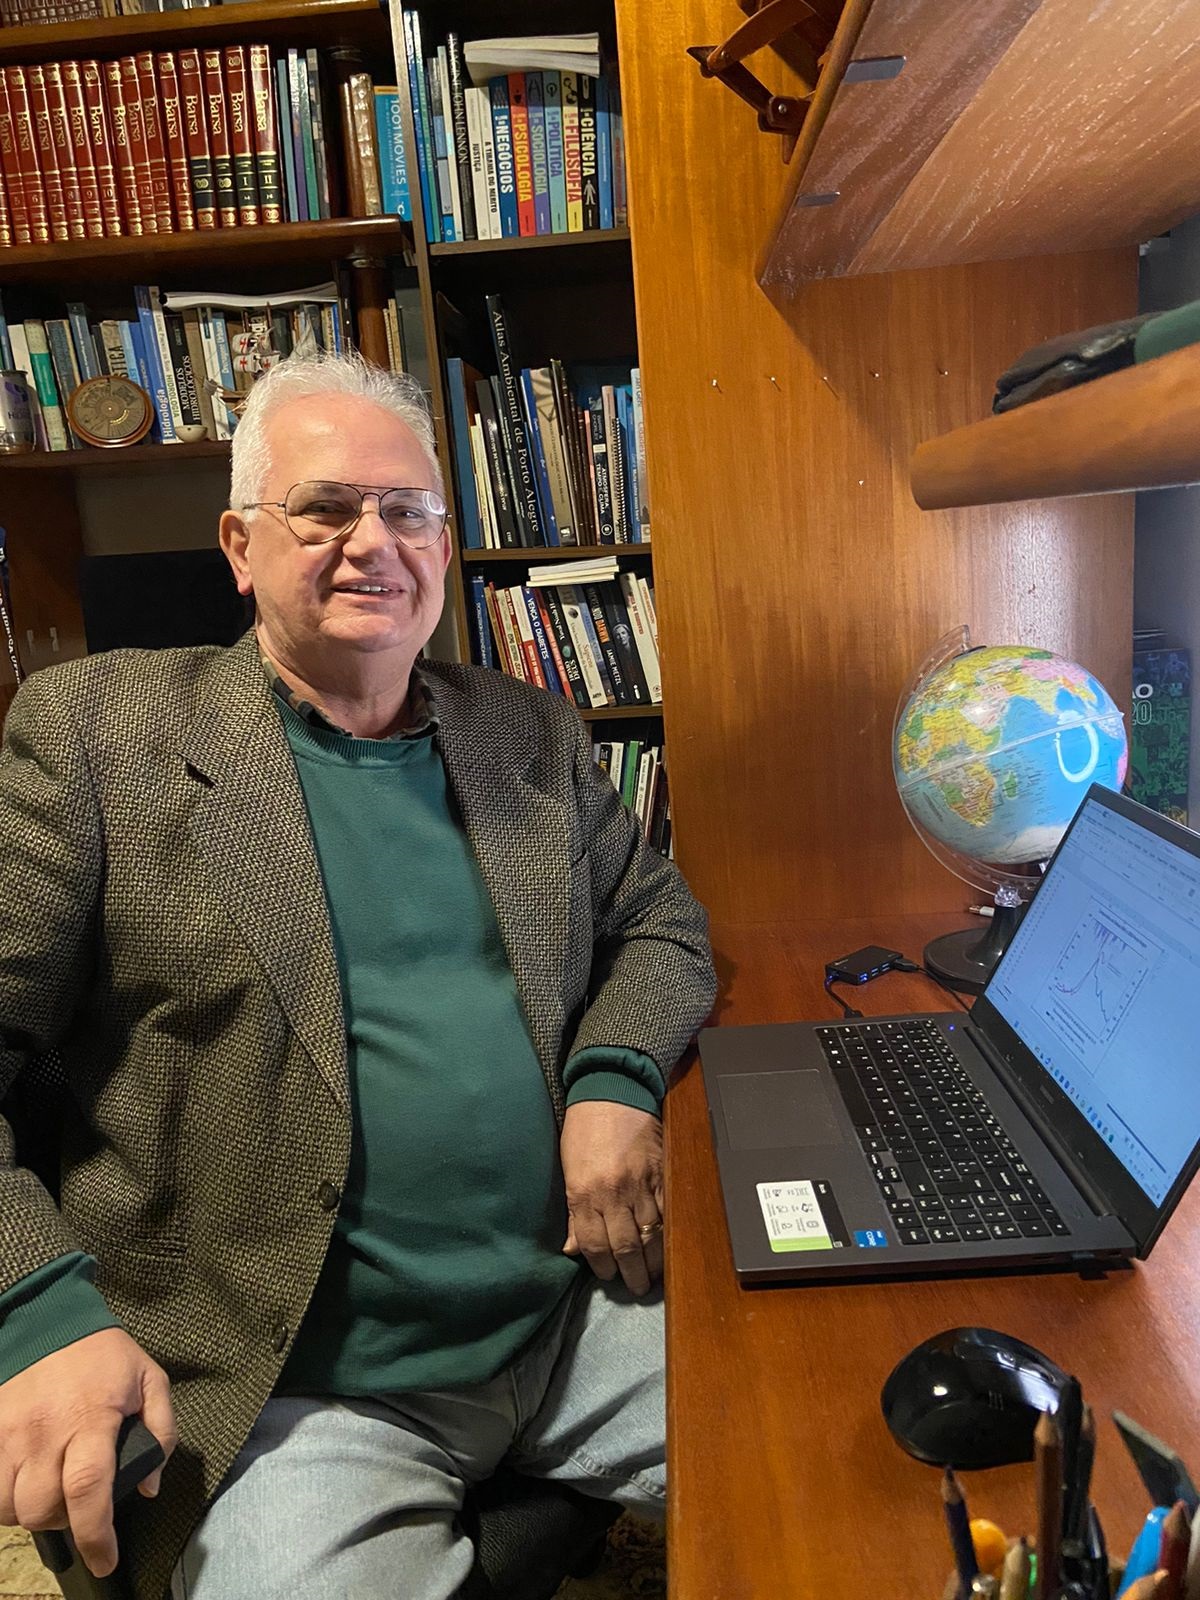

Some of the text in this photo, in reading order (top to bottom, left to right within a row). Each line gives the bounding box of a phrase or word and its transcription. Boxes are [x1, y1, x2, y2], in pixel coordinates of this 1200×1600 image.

[90, 106, 103, 146] Barsa
[113, 105, 126, 146] Barsa
[128, 101, 141, 142] Barsa
[144, 98, 156, 139] Barsa
[164, 98, 178, 139] Barsa
[186, 95, 199, 136] Barsa
[209, 94, 222, 135] Barsa
[231, 91, 244, 133] Barsa
[256, 89, 269, 132] Barsa
[452, 92, 465, 120] JOHN
[16, 112, 30, 150] Barsa
[36, 112, 50, 150] Barsa
[52, 107, 66, 147] Barsa
[71, 107, 85, 147] Barsa
[390, 98, 406, 185] 1001 MOVIES
[455, 121, 468, 164] LENNON
[472, 144, 482, 172] JUSTIÇA
[486, 148, 494, 176] TIRANIA
[496, 125, 513, 194] NEGÓCIOS
[514, 124, 532, 202] PSICOLOGIA
[531, 125, 547, 196] SOCIOLOGIA
[565, 125, 582, 202] FILOSOFIA
[581, 118, 596, 177] CIÊNCIA
[32, 194, 39, 203] 6
[52, 194, 58, 202] 7
[68, 190, 74, 200] 8
[86, 190, 93, 200] 9
[103, 190, 113, 199] 10
[140, 186, 150, 194] 12
[155, 183, 165, 192] 13
[177, 182, 187, 191] 14
[492, 311, 505, 347] Atlas
[166, 374, 180, 418] HIDROLOGIA
[176, 367, 191, 411] MODELOS
[500, 350, 521, 423] Ambiental
[157, 389, 173, 438] Hidrologia
[514, 427, 523, 444] de
[518, 448, 530, 484] Porto
[524, 488, 539, 533] Alegre
[527, 598, 538, 621] VENÇA
[535, 628, 550, 660] DIABETES
[565, 660, 575, 682] HOMO
[570, 659, 580, 680] DEUS
[606, 649, 622, 685] JAMIE METZL
